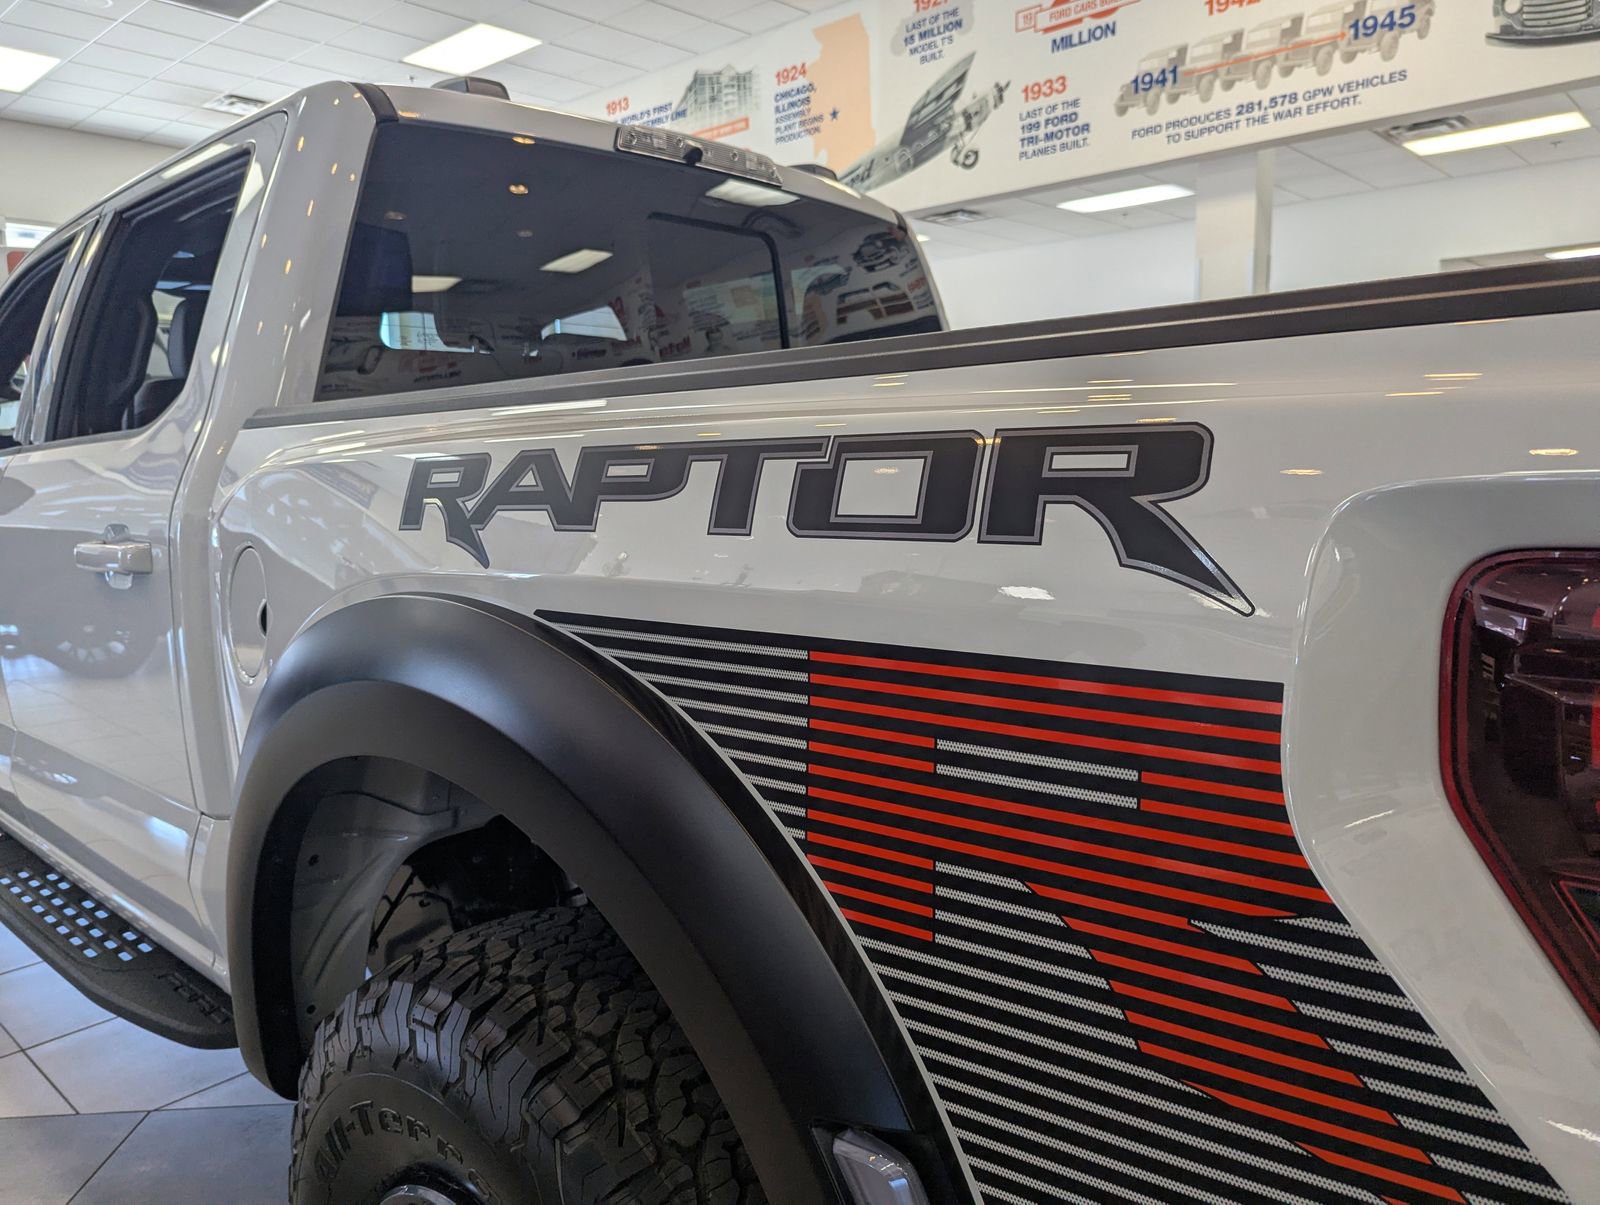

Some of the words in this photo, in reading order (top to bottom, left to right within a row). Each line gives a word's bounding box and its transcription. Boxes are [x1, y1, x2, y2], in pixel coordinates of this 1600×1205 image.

[905, 17, 928, 33] LAST
[928, 14, 941, 25] OF
[942, 7, 960, 20] THE
[1049, 7, 1071, 22] FORD
[1074, 0, 1096, 14] CARS
[1348, 3, 1417, 41] 1945
[903, 34, 915, 47] 15
[918, 18, 963, 42] MILLION
[1051, 21, 1117, 54] MILLION
[909, 40, 939, 56] MODEL
[775, 62, 807, 85] 1924
[1130, 65, 1180, 95] 1941
[774, 82, 817, 104] CHICAGO,
[1020, 75, 1068, 103] 1933
[606, 95, 630, 116] 1913
[652, 102, 673, 116] FIRST
[671, 108, 688, 122] LINE
[774, 96, 812, 115] ILLINOIS
[774, 106, 812, 126] ASSEMBLY
[1019, 107, 1044, 122] LAST
[1045, 103, 1060, 116] OF
[1062, 98, 1081, 111] THE
[1131, 123, 1164, 141] FORD
[1165, 109, 1232, 133] PRODUCES
[1235, 91, 1299, 119] 281,578
[1302, 83, 1335, 102] GPW
[1336, 69, 1409, 96] VEHICLES
[774, 120, 798, 135] PLANT
[798, 113, 824, 129] BEGINS
[1019, 120, 1042, 135] 199
[1044, 111, 1079, 129] FORD
[1165, 132, 1183, 146] TO
[1183, 119, 1242, 142] SUPPORT
[1244, 113, 1270, 129] THE
[1272, 105, 1304, 123] WAR
[1305, 94, 1362, 116] EFFORT.
[1019, 123, 1091, 149] TRI-MOTOR
[1018, 144, 1058, 162] PLANES
[399, 421, 1256, 617] RAPTOR
